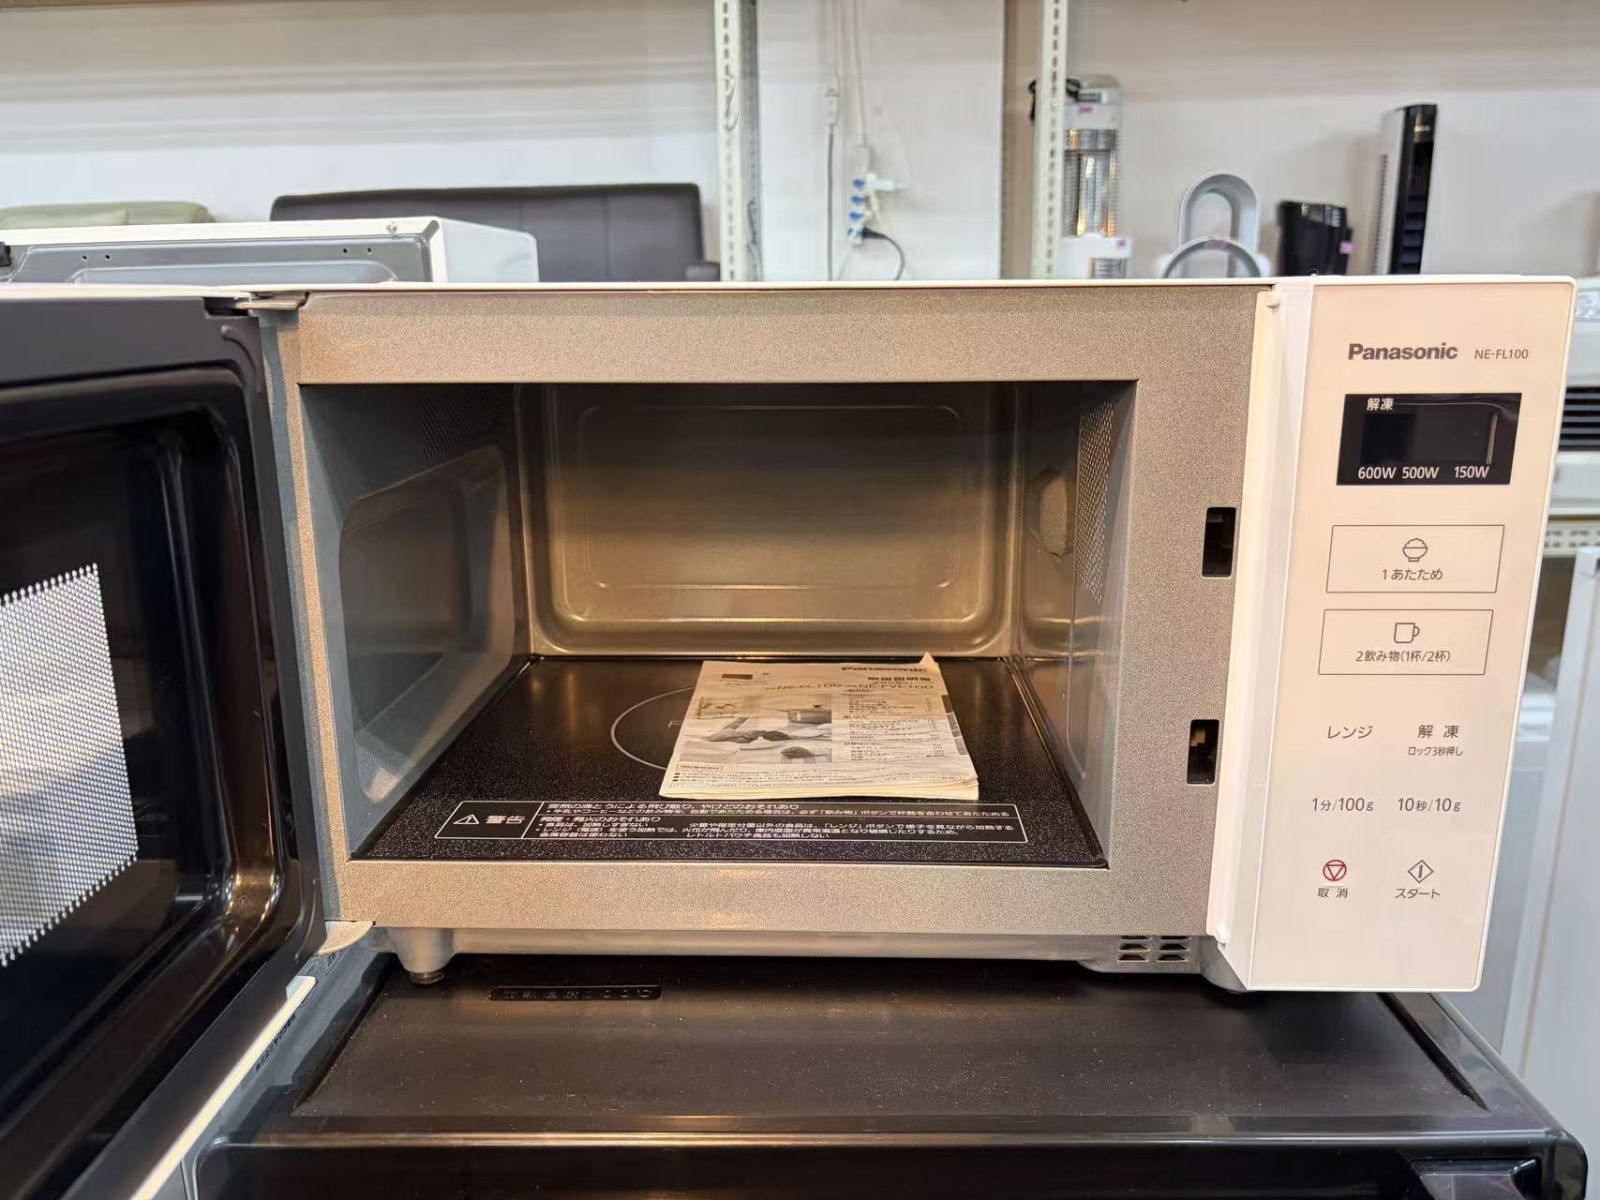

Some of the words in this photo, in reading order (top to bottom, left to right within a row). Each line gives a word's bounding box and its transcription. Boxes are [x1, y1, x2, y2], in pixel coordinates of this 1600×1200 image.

[1348, 342, 1458, 360] Panasonic
[1474, 348, 1529, 360] NE-FL100
[1366, 398, 1394, 411] 解凍
[1358, 466, 1396, 479] 600W
[1401, 466, 1439, 479] 500W
[1454, 466, 1489, 479] 150W
[1327, 725, 1373, 739] レンジ
[1407, 746, 1463, 756] ロック3秒押し
[1312, 797, 1374, 812] 1分/100g
[1398, 797, 1461, 812] 10秒/10g
[485, 815, 526, 825] 警告
[1317, 887, 1349, 899] 取消
[1395, 888, 1440, 899] スタート
